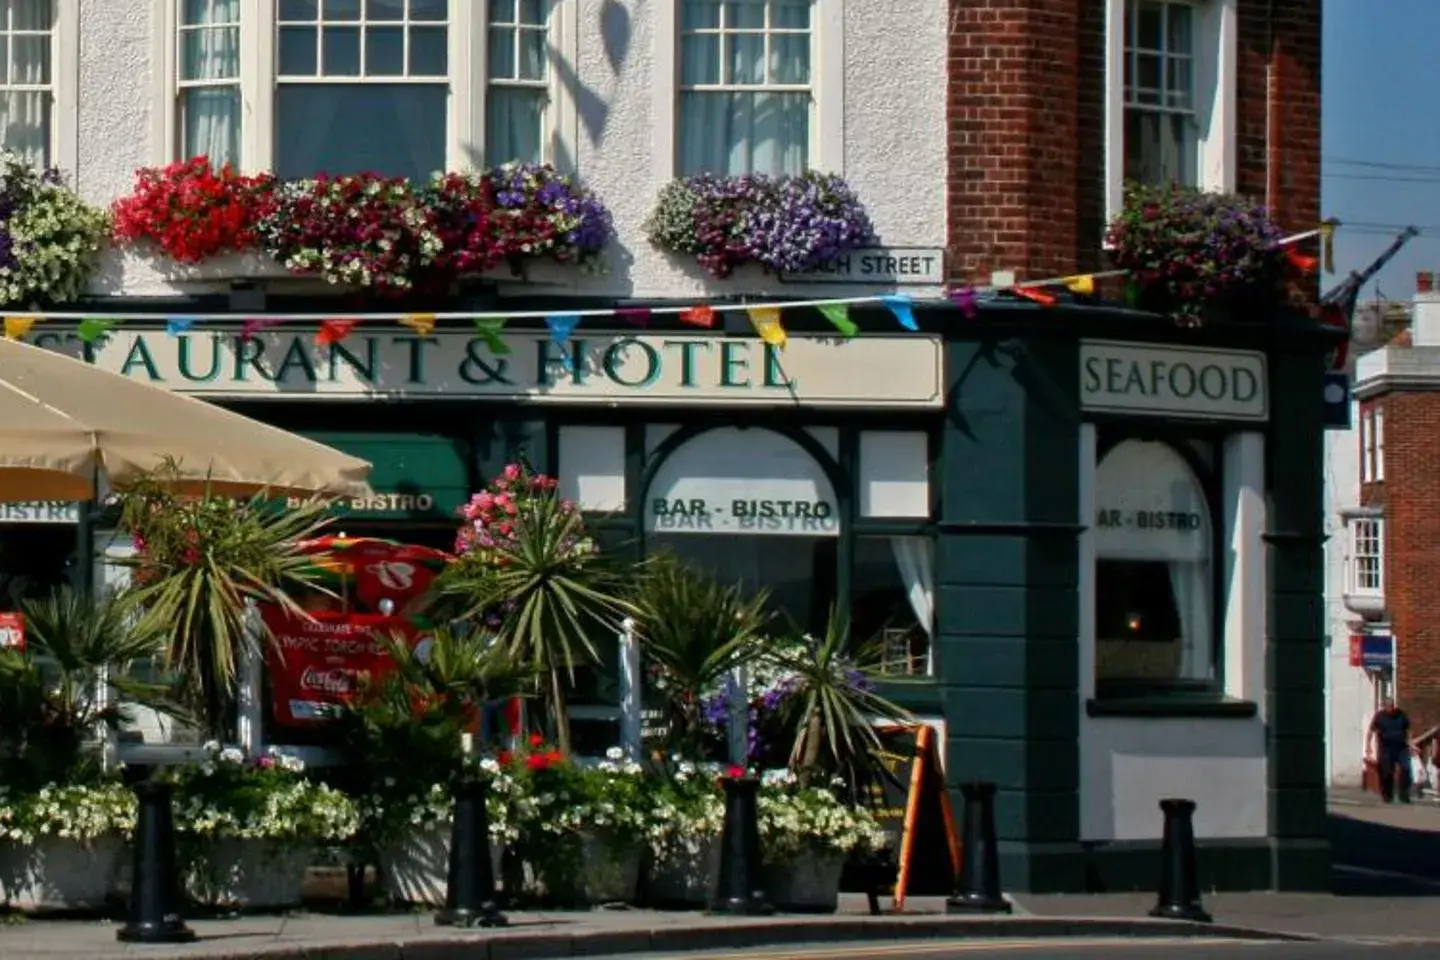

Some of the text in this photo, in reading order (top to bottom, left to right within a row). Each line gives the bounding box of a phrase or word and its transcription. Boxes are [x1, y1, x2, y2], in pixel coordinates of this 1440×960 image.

[860, 256, 936, 275] STREET
[459, 338, 515, 386] &
[537, 339, 798, 389] HOTEL
[1084, 356, 1259, 403] SEAFOOD
[352, 493, 433, 511] BISTRO
[652, 498, 706, 516] BAR
[731, 499, 830, 519] BISTRO
[1097, 508, 1122, 528] AR
[1137, 510, 1201, 530] BISTRO
